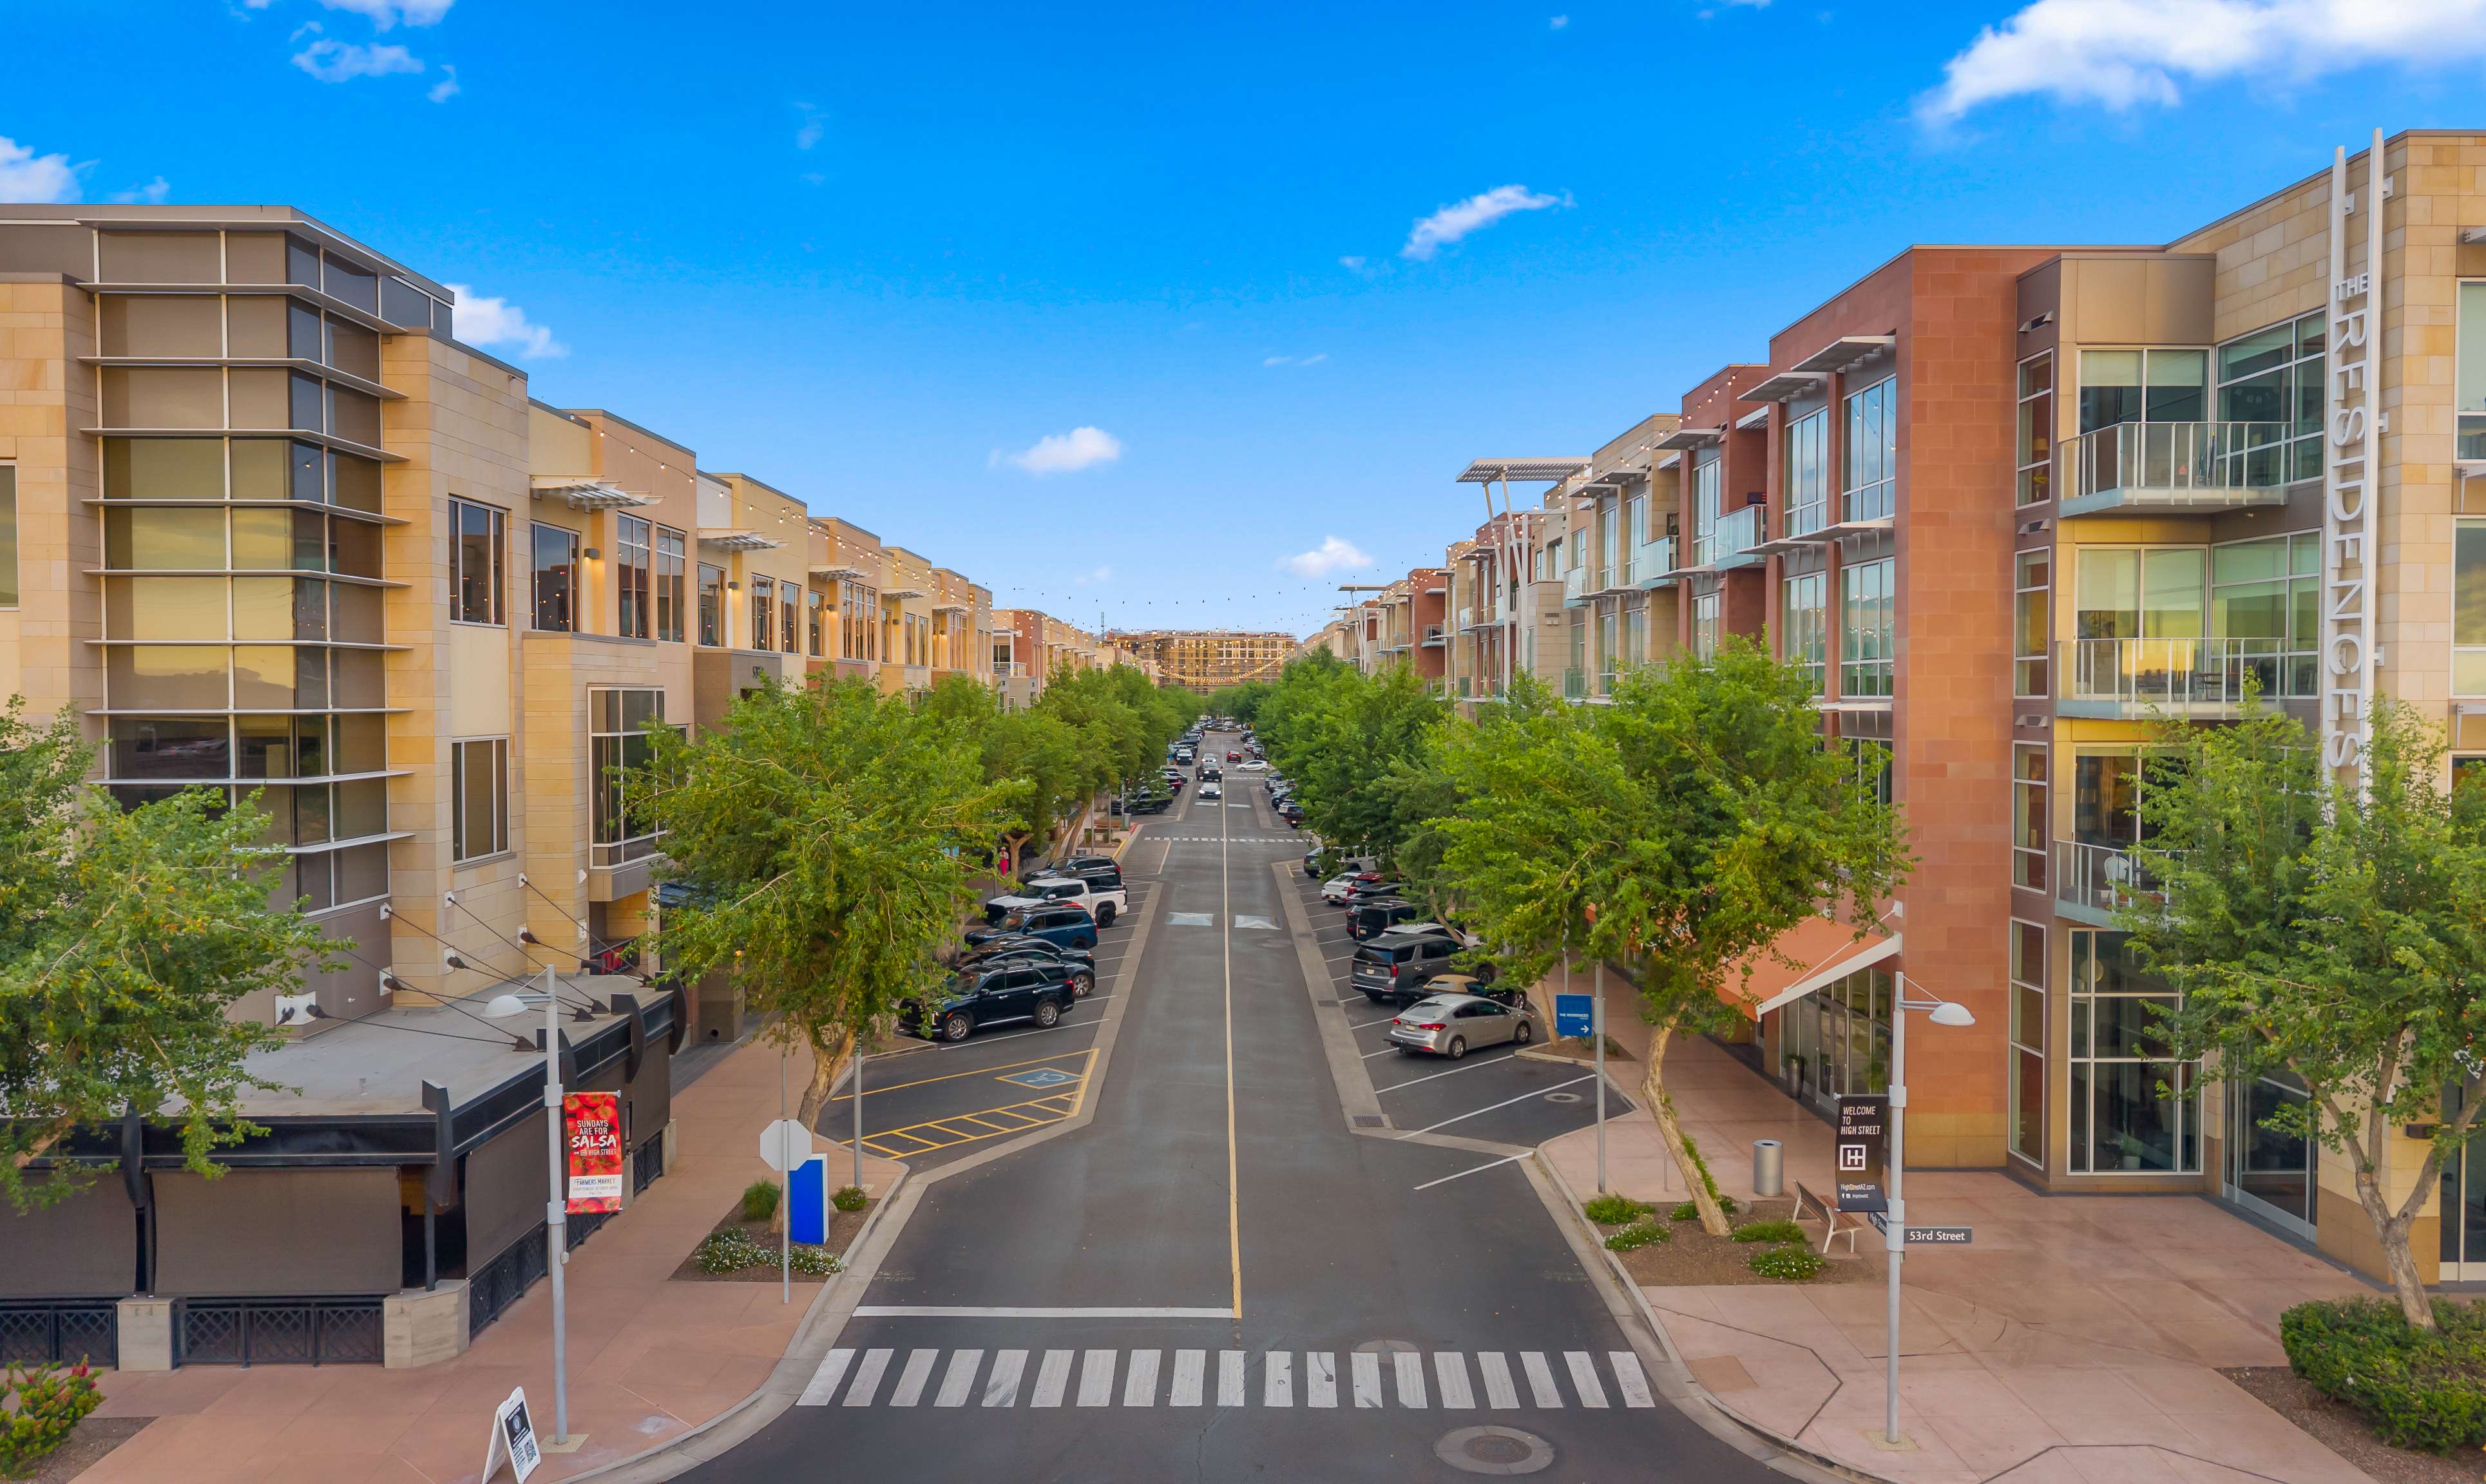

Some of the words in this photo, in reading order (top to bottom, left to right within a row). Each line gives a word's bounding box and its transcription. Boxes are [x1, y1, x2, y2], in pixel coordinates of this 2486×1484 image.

[2335, 272, 2368, 301] THE
[2326, 308, 2369, 766] RESIDENCES
[1843, 1107, 1875, 1115] WELCOME
[1842, 1116, 1851, 1125] TO
[1841, 1126, 1857, 1134] HIGH
[1858, 1126, 1880, 1134] STREET
[571, 1134, 617, 1148] SALSA
[1909, 1230, 1933, 1241] 53rd
[1936, 1231, 1965, 1241] Street
